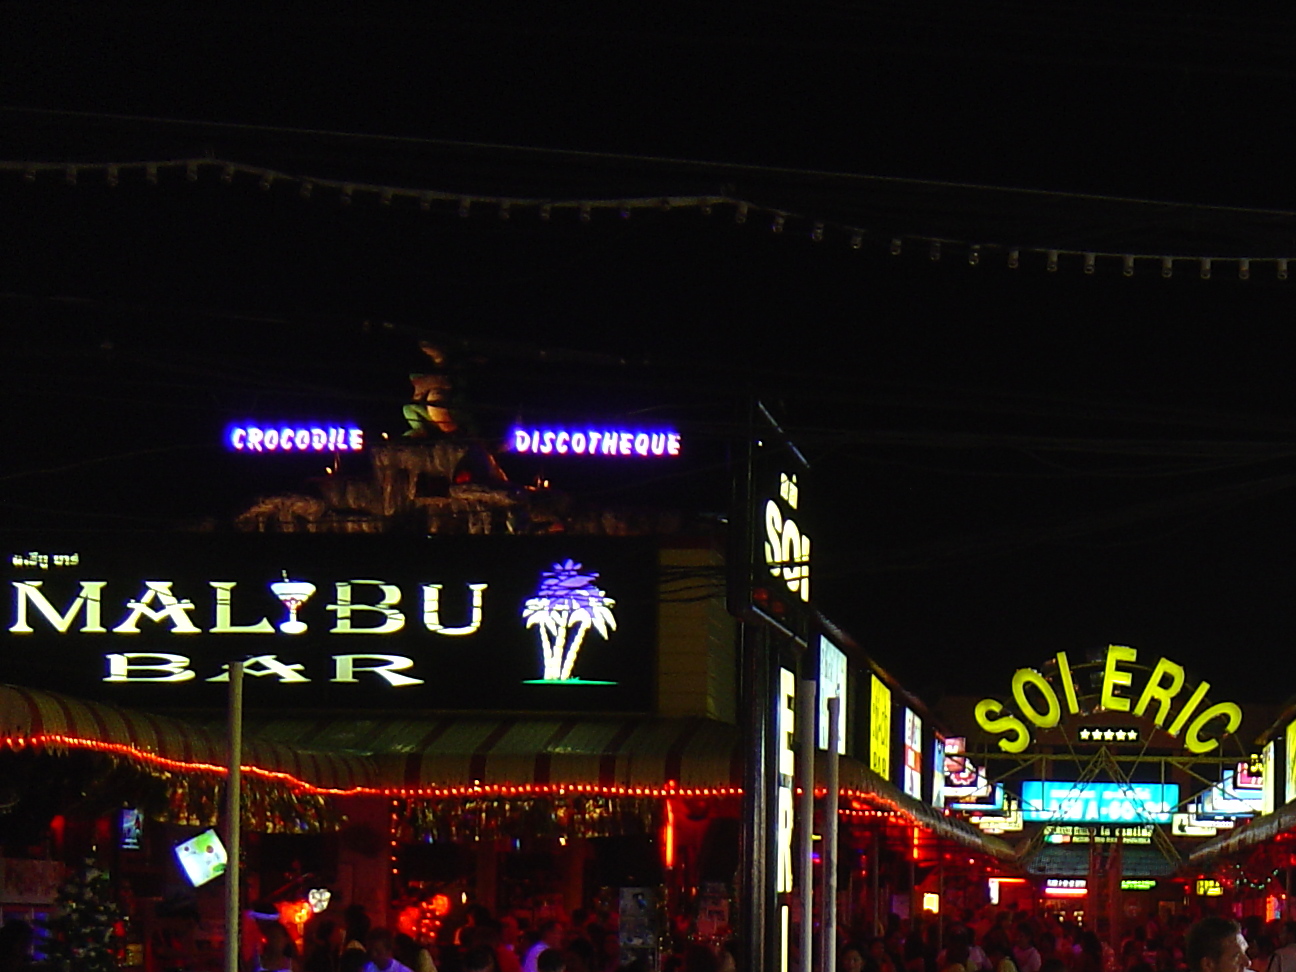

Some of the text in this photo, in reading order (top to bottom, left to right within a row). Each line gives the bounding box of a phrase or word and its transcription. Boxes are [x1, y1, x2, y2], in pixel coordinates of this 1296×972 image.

[231, 425, 364, 452] CROCODILE
[514, 429, 682, 456] DISCOTHEQUE
[764, 499, 811, 603] SOI
[9, 575, 488, 636] MALIBU
[103, 653, 424, 686] BAR
[974, 651, 1080, 754] SOI
[1100, 644, 1243, 754] ERIC
